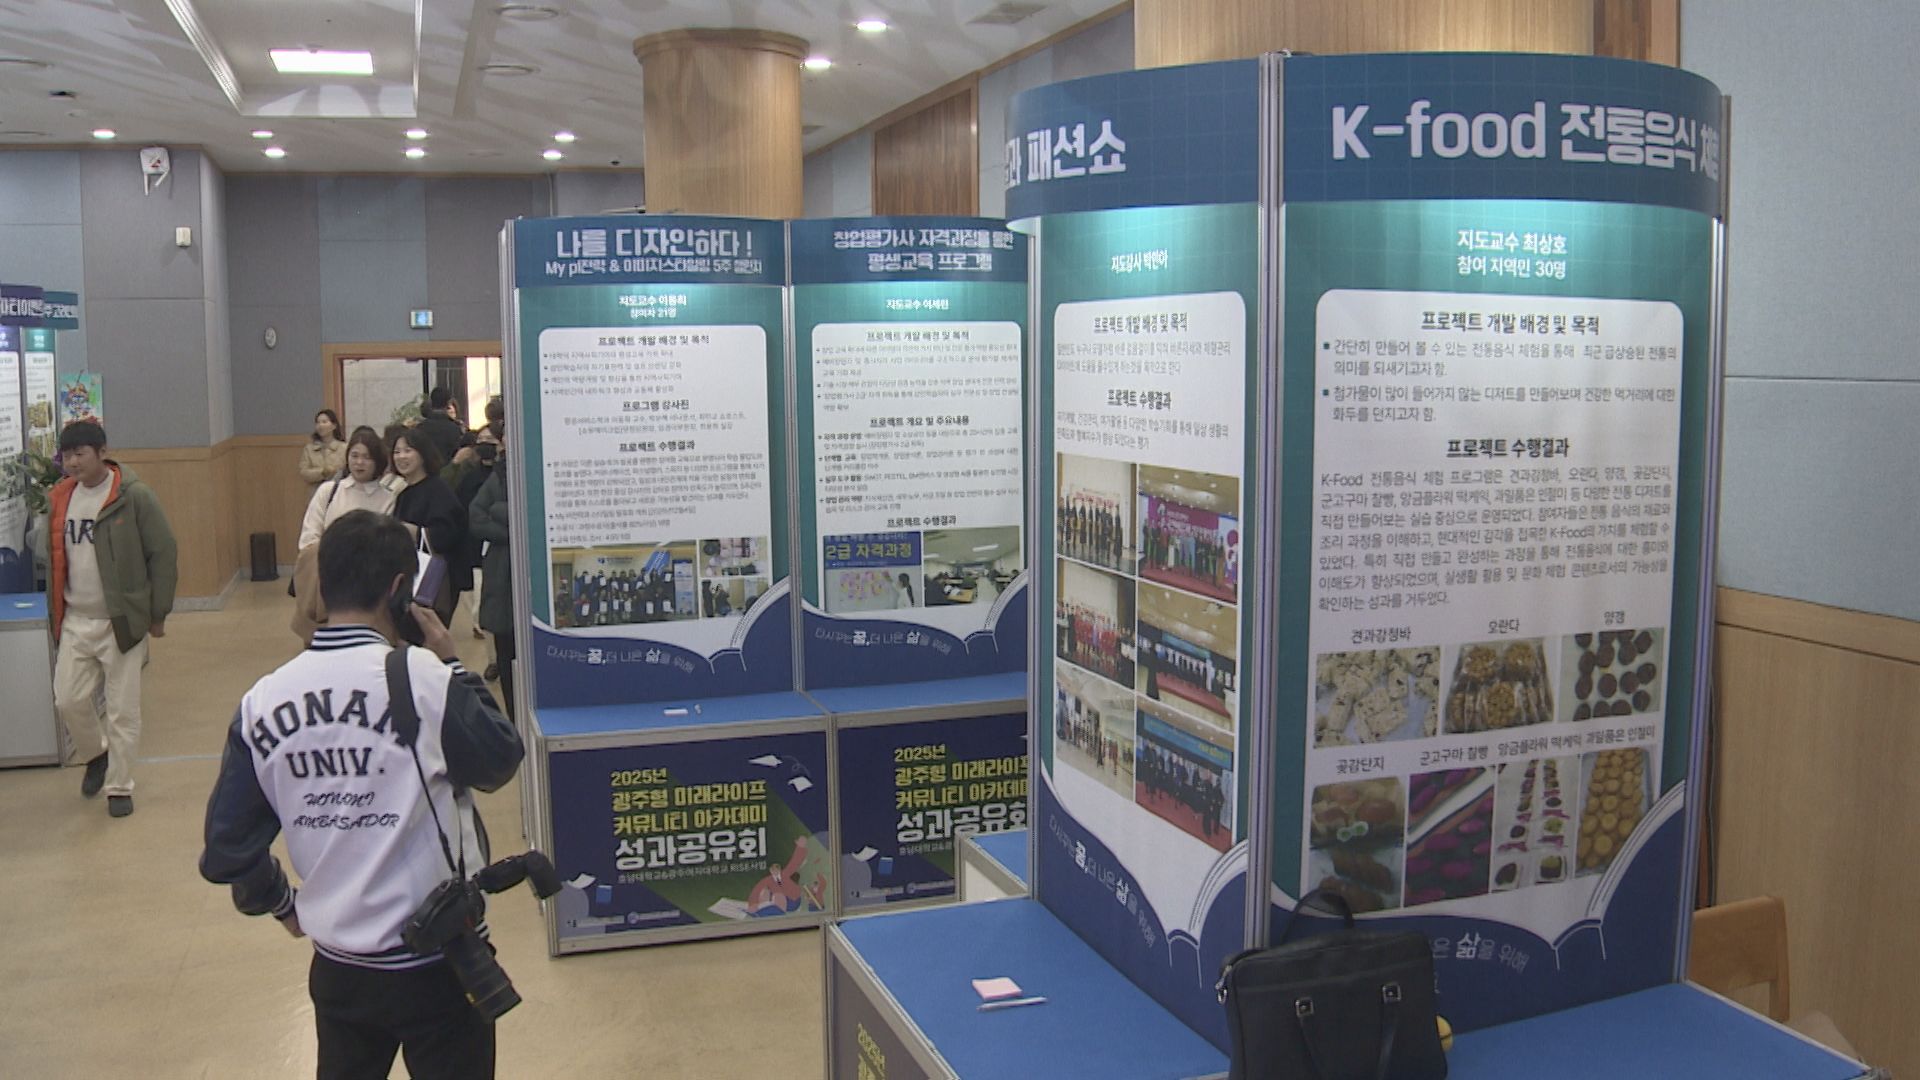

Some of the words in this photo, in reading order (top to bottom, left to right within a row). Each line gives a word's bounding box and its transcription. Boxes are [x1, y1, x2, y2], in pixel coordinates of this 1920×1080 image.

[1331, 99, 1546, 160] K-food
[1560, 103, 1696, 173] 전통음식
[1027, 120, 1126, 181] 패션쇼
[556, 228, 607, 259] 나를
[833, 229, 915, 249] 창업평가사
[919, 228, 991, 248] 자격과정을
[1457, 229, 1520, 253] 지도교수
[1523, 231, 1568, 256] 최상호
[867, 252, 934, 272] 평생교육
[938, 252, 993, 272] 프로그램
[1457, 255, 1487, 276] 참여
[1490, 257, 1531, 278] 지역민
[1535, 259, 1566, 280] 30명
[1421, 311, 1483, 332] 프로젝트
[1487, 313, 1516, 334] 개발
[1520, 314, 1549, 335] 배경
[1553, 315, 1567, 335] 및
[1572, 315, 1599, 336] 목적
[1334, 339, 1370, 356] 간단히
[1375, 340, 1410, 356] 만들어
[1431, 342, 1442, 356] 수
[1445, 342, 1467, 357] 있는
[1473, 343, 1515, 358] 전통음식
[1334, 361, 1369, 376] 의미를
[1334, 385, 1382, 401] 첨가물이
[1385, 385, 1409, 401] 많이
[1412, 385, 1455, 401] 들어가지
[1458, 386, 1482, 402] 않는
[1484, 386, 1526, 402] 디저트를
[1585, 387, 1612, 402] 건강한
[1656, 387, 1676, 402] 대한
[1333, 407, 1369, 422] 화두를
[1373, 407, 1420, 422] 던지고자
[1446, 438, 1508, 459] 프로젝트
[1511, 437, 1570, 458] 수행결과
[1321, 472, 1363, 488] K-Food
[1370, 471, 1416, 487] 전통음식
[1423, 471, 1444, 487] 체험
[1450, 469, 1503, 485] 프로그램은
[1320, 492, 1368, 509] 군고구마
[1570, 487, 1581, 501] 등
[1321, 514, 1344, 530] 직접
[1347, 513, 1406, 529] 만들어보는
[1410, 511, 1432, 528] 실습
[1435, 510, 1478, 526] 중심으로
[1320, 535, 1343, 550] 조리
[1348, 534, 1383, 550] 과정을
[1387, 533, 1434, 549] 이해하고,
[1437, 531, 1480, 547] 현대적인
[1364, 553, 1387, 569] 특히
[1393, 552, 1416, 568] 직접
[1421, 550, 1452, 566] 만들고
[1319, 574, 1366, 591] 이해도가
[1371, 572, 1440, 590] 향상되었으며,
[1319, 595, 1365, 612] 확인하는
[1368, 593, 1402, 610] 성과를
[1488, 618, 1520, 635] 오란다
[1604, 611, 1625, 625] 양갱
[894, 743, 946, 763] 2025년
[1420, 748, 1463, 766] 군고구마
[1336, 757, 1385, 775] 곶감단지
[610, 768, 667, 787] 2025년
[611, 788, 669, 812] 광주형
[674, 780, 766, 806] 미래라이프
[614, 811, 688, 836] 커뮤니티
[694, 804, 767, 828] 아카데미
[615, 827, 766, 871] 성과공유회
